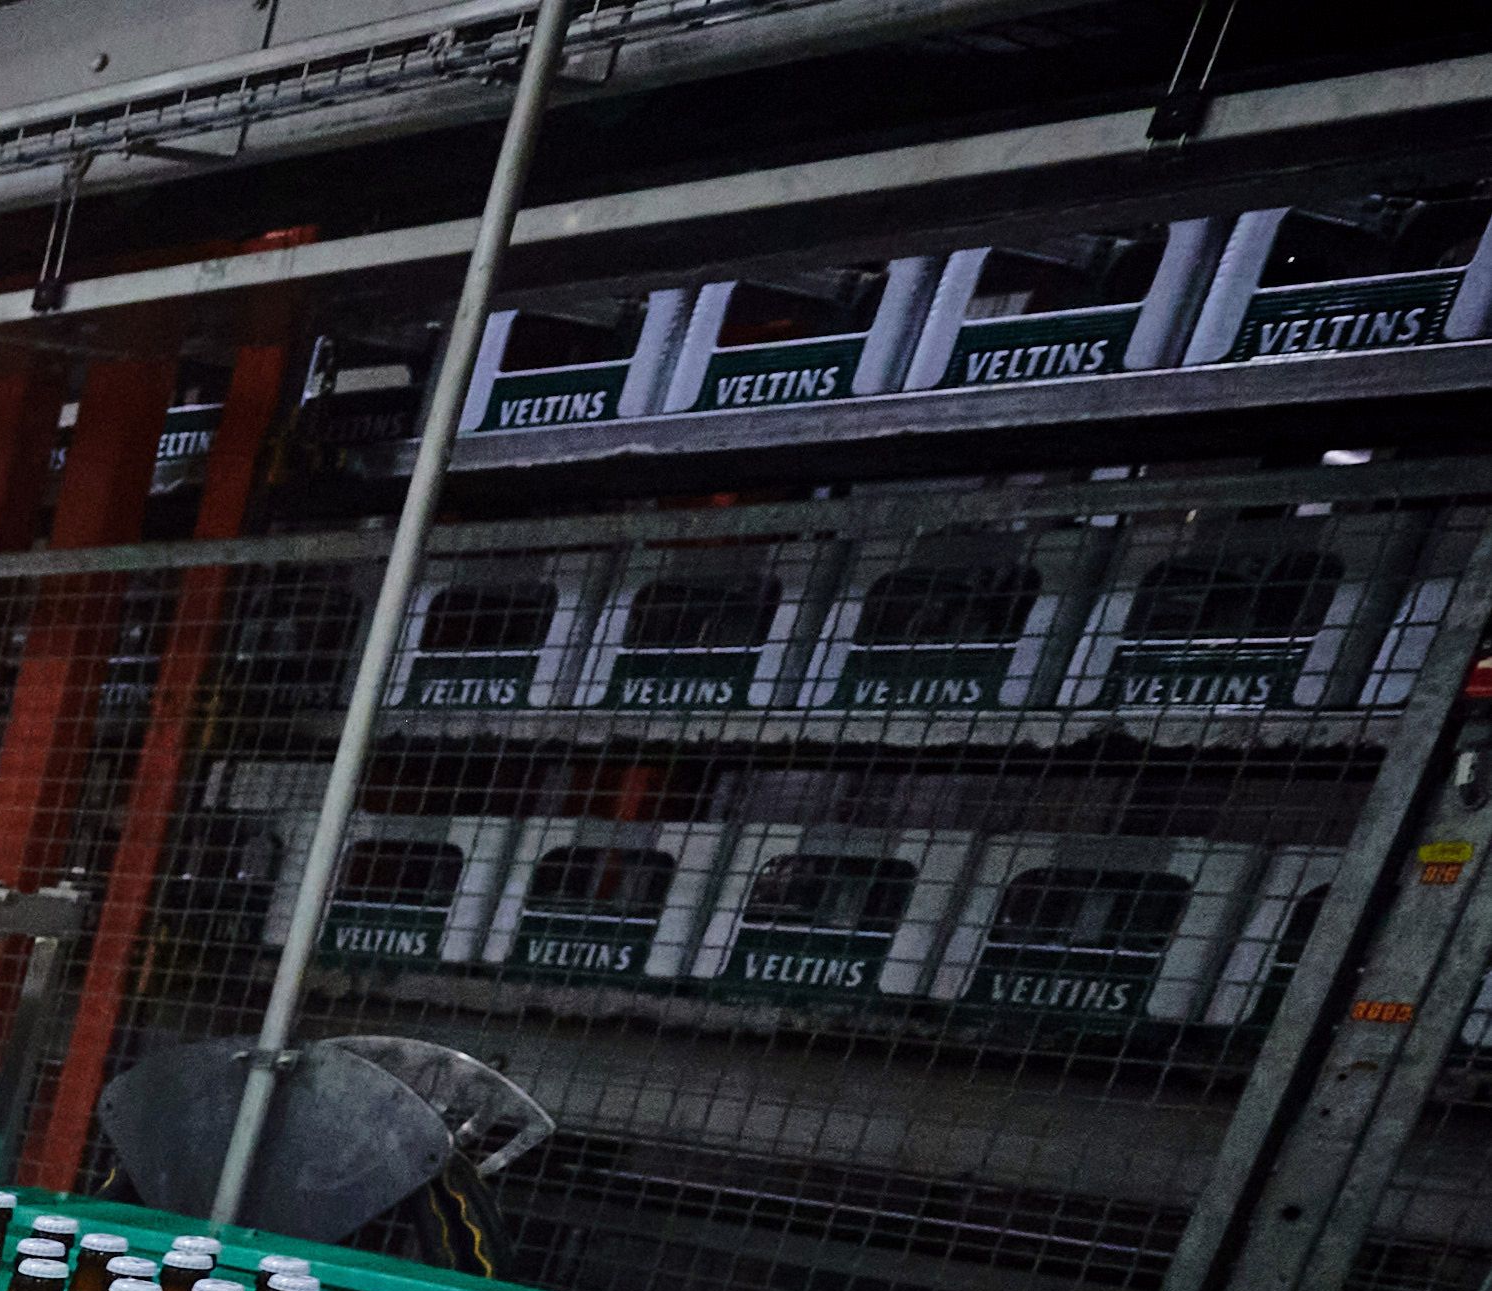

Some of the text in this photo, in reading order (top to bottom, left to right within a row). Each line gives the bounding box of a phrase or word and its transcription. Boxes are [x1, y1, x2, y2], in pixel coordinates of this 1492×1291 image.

[1259, 306, 1426, 354] VELTINS
[966, 338, 1109, 383] VELTINS
[717, 366, 840, 405] VELTINS
[499, 391, 605, 427] VELTINS
[156, 431, 213, 458] ELTIN
[335, 925, 429, 958] VELTINS
[528, 939, 634, 972] VELTINS
